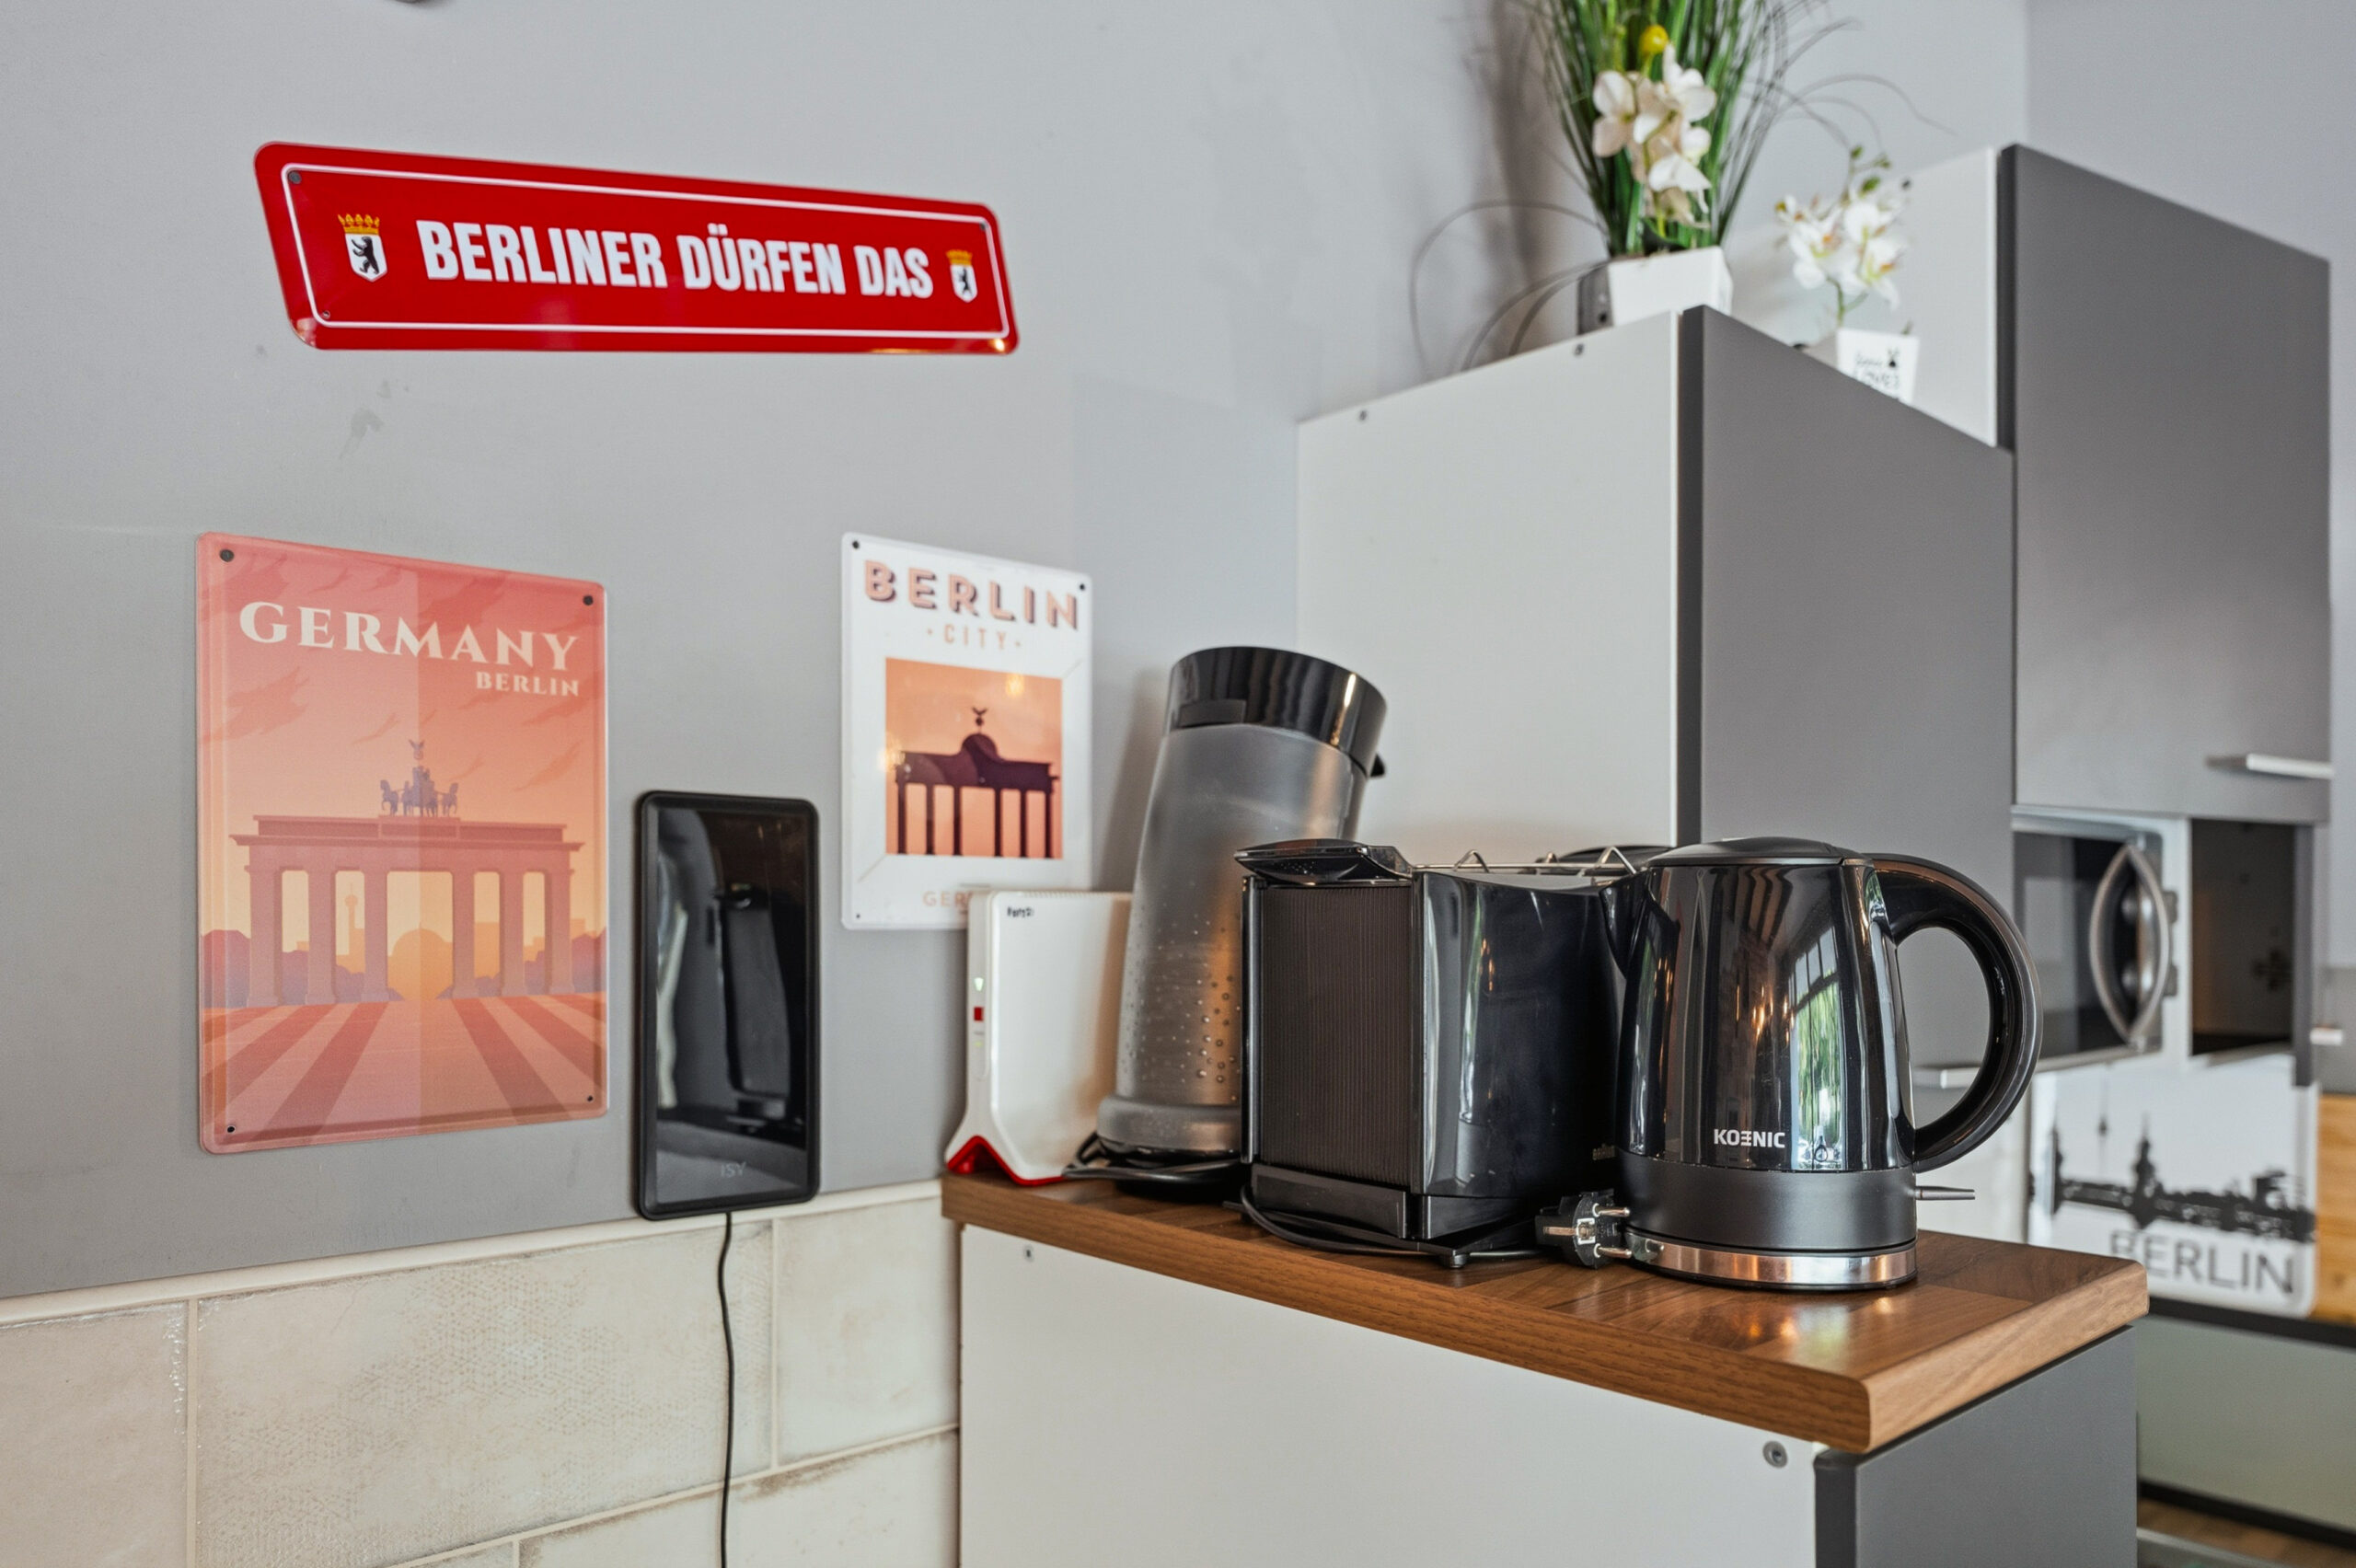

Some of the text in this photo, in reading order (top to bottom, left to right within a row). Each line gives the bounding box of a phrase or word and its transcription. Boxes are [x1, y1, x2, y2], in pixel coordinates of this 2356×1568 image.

[415, 219, 934, 297] BERLINER DÜRFEN DAS
[864, 559, 1078, 629] BERLIN
[239, 600, 579, 672] GERMANY
[943, 623, 1007, 650] CITY
[476, 671, 580, 697] BERLIN
[1713, 1128, 1785, 1148] KOENIC
[721, 1161, 747, 1178] ISY
[2111, 1228, 2294, 1295] BERLIN
